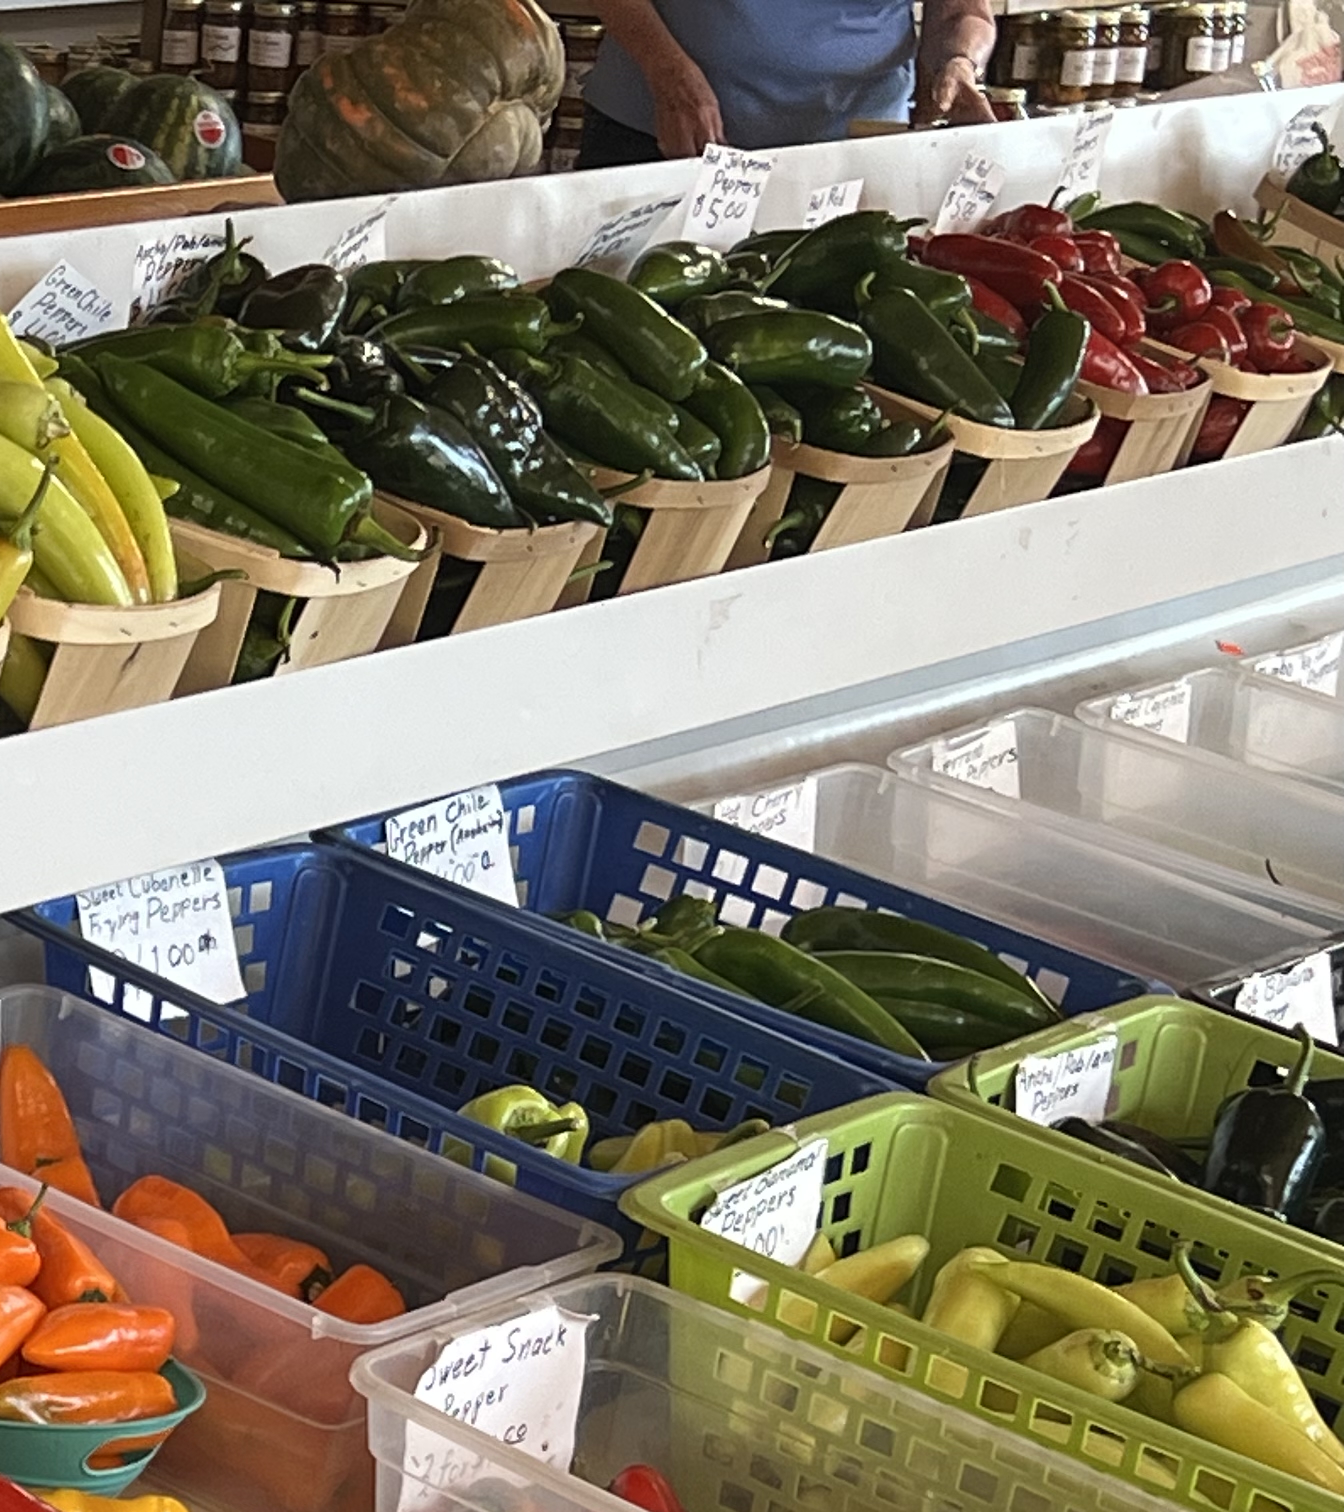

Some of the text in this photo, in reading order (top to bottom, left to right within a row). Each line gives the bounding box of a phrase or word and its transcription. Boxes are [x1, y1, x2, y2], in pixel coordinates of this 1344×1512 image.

[45, 265, 83, 299] Green
[77, 289, 113, 323] Chile
[390, 793, 490, 853] Green Chile
[146, 892, 221, 928] Peppers
[721, 1185, 797, 1235] Peppers
[425, 1324, 567, 1391] Sweet Snack
